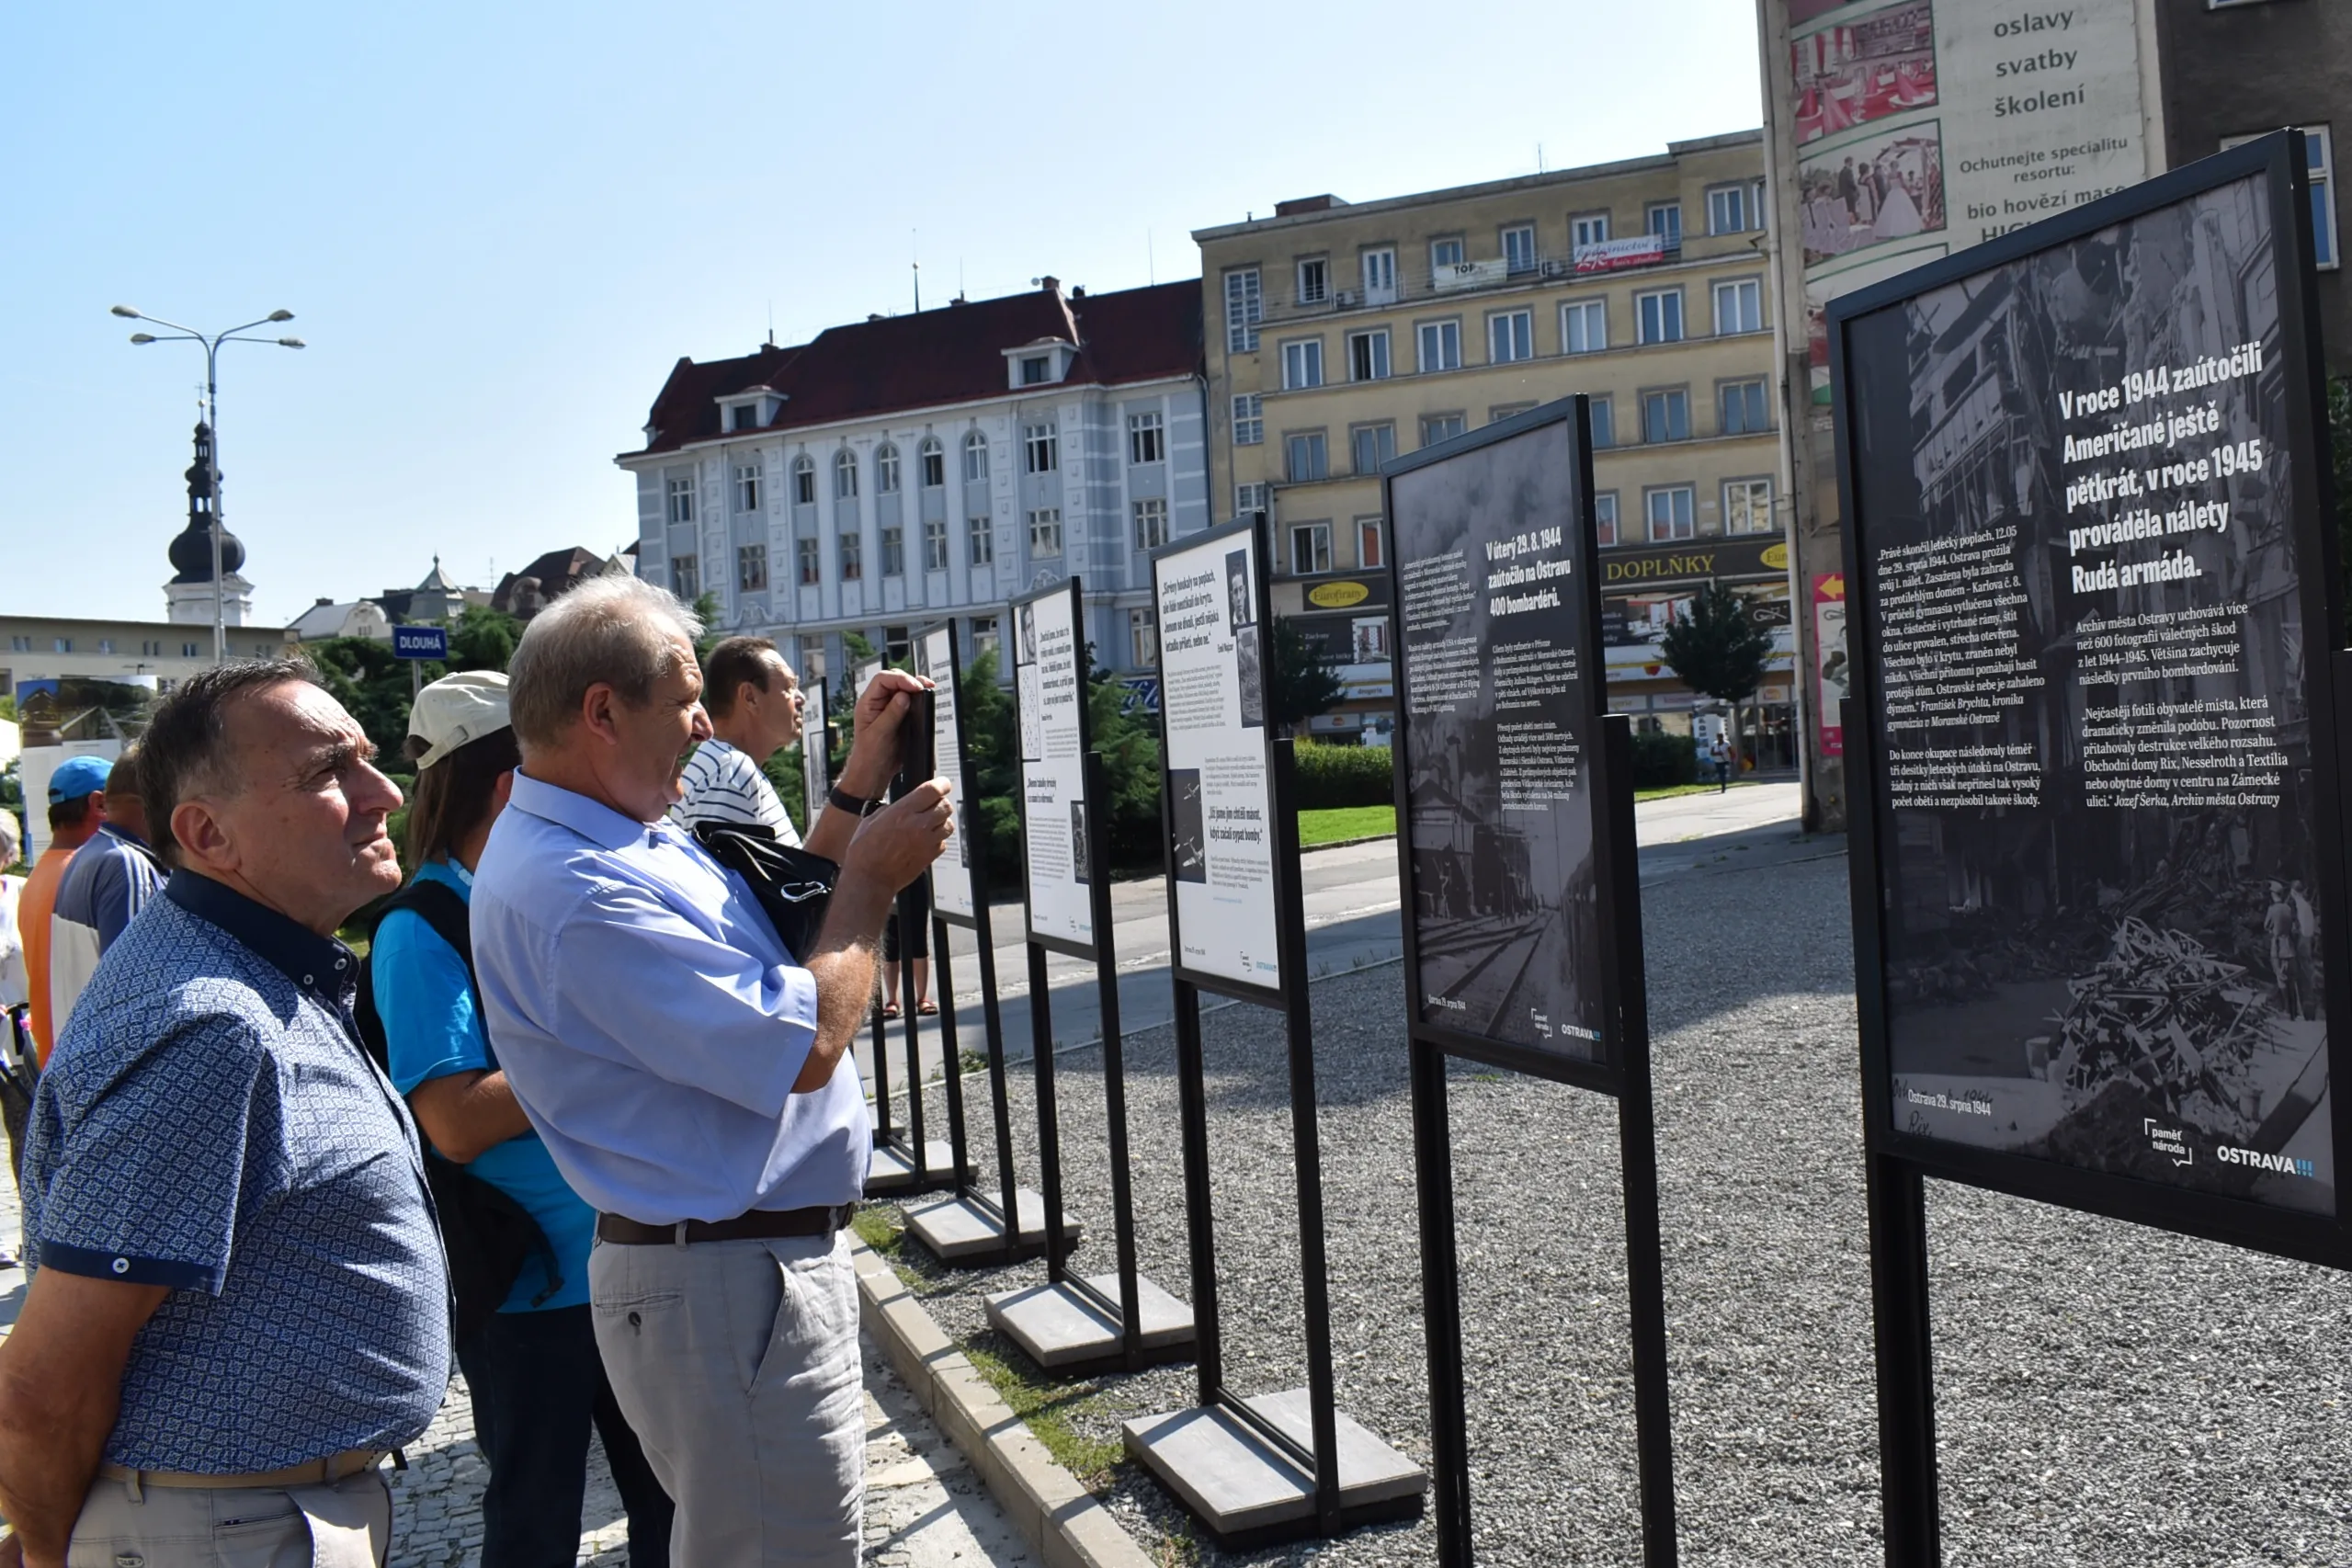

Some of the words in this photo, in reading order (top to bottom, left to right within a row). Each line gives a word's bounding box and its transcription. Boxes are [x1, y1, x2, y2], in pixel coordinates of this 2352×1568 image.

[1994, 11, 2074, 37] oslavy
[1996, 48, 2077, 76] svatby
[1994, 85, 2085, 117] školení
[1960, 149, 2046, 173] Ochutnejte
[2051, 137, 2128, 162] specialitu
[2015, 165, 2075, 182] resortu:
[1968, 201, 1997, 219] bio
[2004, 187, 2067, 213] hovězí
[2059, 392, 2072, 421] V
[2076, 387, 2119, 417] roce
[2121, 367, 2168, 404] 1944
[2173, 342, 2262, 392] zaútočili
[2064, 411, 2164, 463] Američané
[2168, 399, 2219, 448] ještě
[2066, 465, 2142, 514] pětkrát,
[2147, 470, 2157, 491] v
[2162, 460, 2210, 488] roce
[2212, 443, 2262, 479] 1945
[2070, 507, 2162, 557] prováděla
[2166, 500, 2229, 535] nálety
[1486, 542, 1493, 561] V
[1494, 536, 1515, 561] úterý
[1517, 535, 1529, 554] 29.
[1531, 533, 1540, 551] 8.
[1540, 528, 1562, 550] 1944
[1902, 541, 1929, 556] skončil
[1930, 537, 1958, 551] letecký
[1960, 530, 1994, 548] poplach,
[1995, 527, 2017, 540] 12.05
[1488, 564, 1524, 588] zaútočilo
[1526, 567, 1535, 582] na
[1537, 561, 1571, 579] Ostravu
[1608, 554, 1715, 580] DOPLŇKY
[2072, 557, 2117, 594] Rudá
[2121, 549, 2202, 586] armáda.
[1490, 597, 1505, 617] 400
[1506, 587, 1561, 614] bombardérů.
[2075, 619, 2106, 632] Archiv
[2108, 616, 2136, 629] města
[2138, 613, 2176, 626] Ostravy
[2177, 605, 2224, 621] uchovává
[2226, 603, 2248, 616] více
[400, 634, 441, 650] DLOUHÁ
[2077, 638, 2092, 651] než
[2095, 636, 2112, 649] 600
[2114, 631, 2158, 648] fotografií
[2160, 625, 2209, 642] válečných
[2211, 622, 2236, 636] škod
[2078, 659, 2083, 667] z
[2085, 655, 2096, 666] let
[2099, 651, 2149, 665] 1944–1945.
[2152, 647, 2187, 660] Většina
[2189, 642, 2240, 658] zachycuje
[2079, 671, 2119, 685] následky
[2121, 667, 2160, 685] prvního
[2162, 661, 2239, 678] bombardování.
[2132, 704, 2154, 717] fotili
[2156, 700, 2203, 717] obyvatelé
[2205, 700, 2237, 712] místa,
[2240, 697, 2267, 710] která
[2082, 723, 2134, 737] dramaticky
[2136, 721, 2176, 733] změnila
[2177, 719, 2219, 734] podobu.
[2221, 717, 2276, 729] Pozornost
[1890, 750, 1900, 759] Do
[1902, 749, 1923, 759] konce
[1925, 748, 1957, 760] okupace
[1959, 745, 2005, 757] následovaly
[2006, 744, 2032, 755] téměř
[2084, 741, 2135, 757] přitahovaly
[2137, 739, 2186, 752] destrukce
[2188, 737, 2228, 749] velkého
[2230, 735, 2277, 747] rozsahu.
[1891, 765, 1899, 775] tři
[1901, 765, 1927, 777] desítky
[1929, 764, 1966, 776] leteckých
[1968, 763, 1991, 773] útoků
[2005, 763, 2040, 773] Ostravu,
[2085, 759, 2129, 771] Obchodní
[2131, 759, 2158, 772] domy
[2160, 758, 2179, 771] Rix,
[2182, 756, 2236, 768] Nesselroth
[2238, 758, 2244, 767] a
[2246, 754, 2288, 767] Textilia
[1892, 780, 1913, 792] žádný
[1920, 780, 1937, 790] nich
[1938, 779, 1956, 790] však
[1957, 779, 1995, 791] nepřinesl
[1996, 778, 2010, 789] tak
[2012, 778, 2040, 790] vysoký
[2085, 778, 2108, 789] nebo
[2109, 777, 2142, 791] obytné
[2143, 777, 2170, 790] domy
[2180, 777, 2214, 787] centru
[2232, 774, 2279, 786] Zámecké
[1892, 796, 1912, 809] počet
[1914, 796, 1933, 805] obětí
[1940, 795, 1983, 808] nezpůsobil
[1985, 795, 2011, 805] takové
[2013, 795, 2040, 807] škody.
[2112, 795, 2137, 806] Jozef
[2140, 793, 2169, 808] Šerka,
[2171, 794, 2204, 805] Archiv
[2206, 793, 2235, 805] města
[2237, 794, 2279, 807] Ostravy
[1428, 996, 1441, 1006] Ostrava
[1458, 1002, 1466, 1010] 1944
[1908, 1090, 1936, 1106] Ostrava
[1937, 1095, 1948, 1108] 29.
[1949, 1100, 1971, 1113] srpna
[1973, 1100, 1992, 1115] 1944
[2153, 1128, 2182, 1142] paměť
[2153, 1140, 2186, 1154] národa
